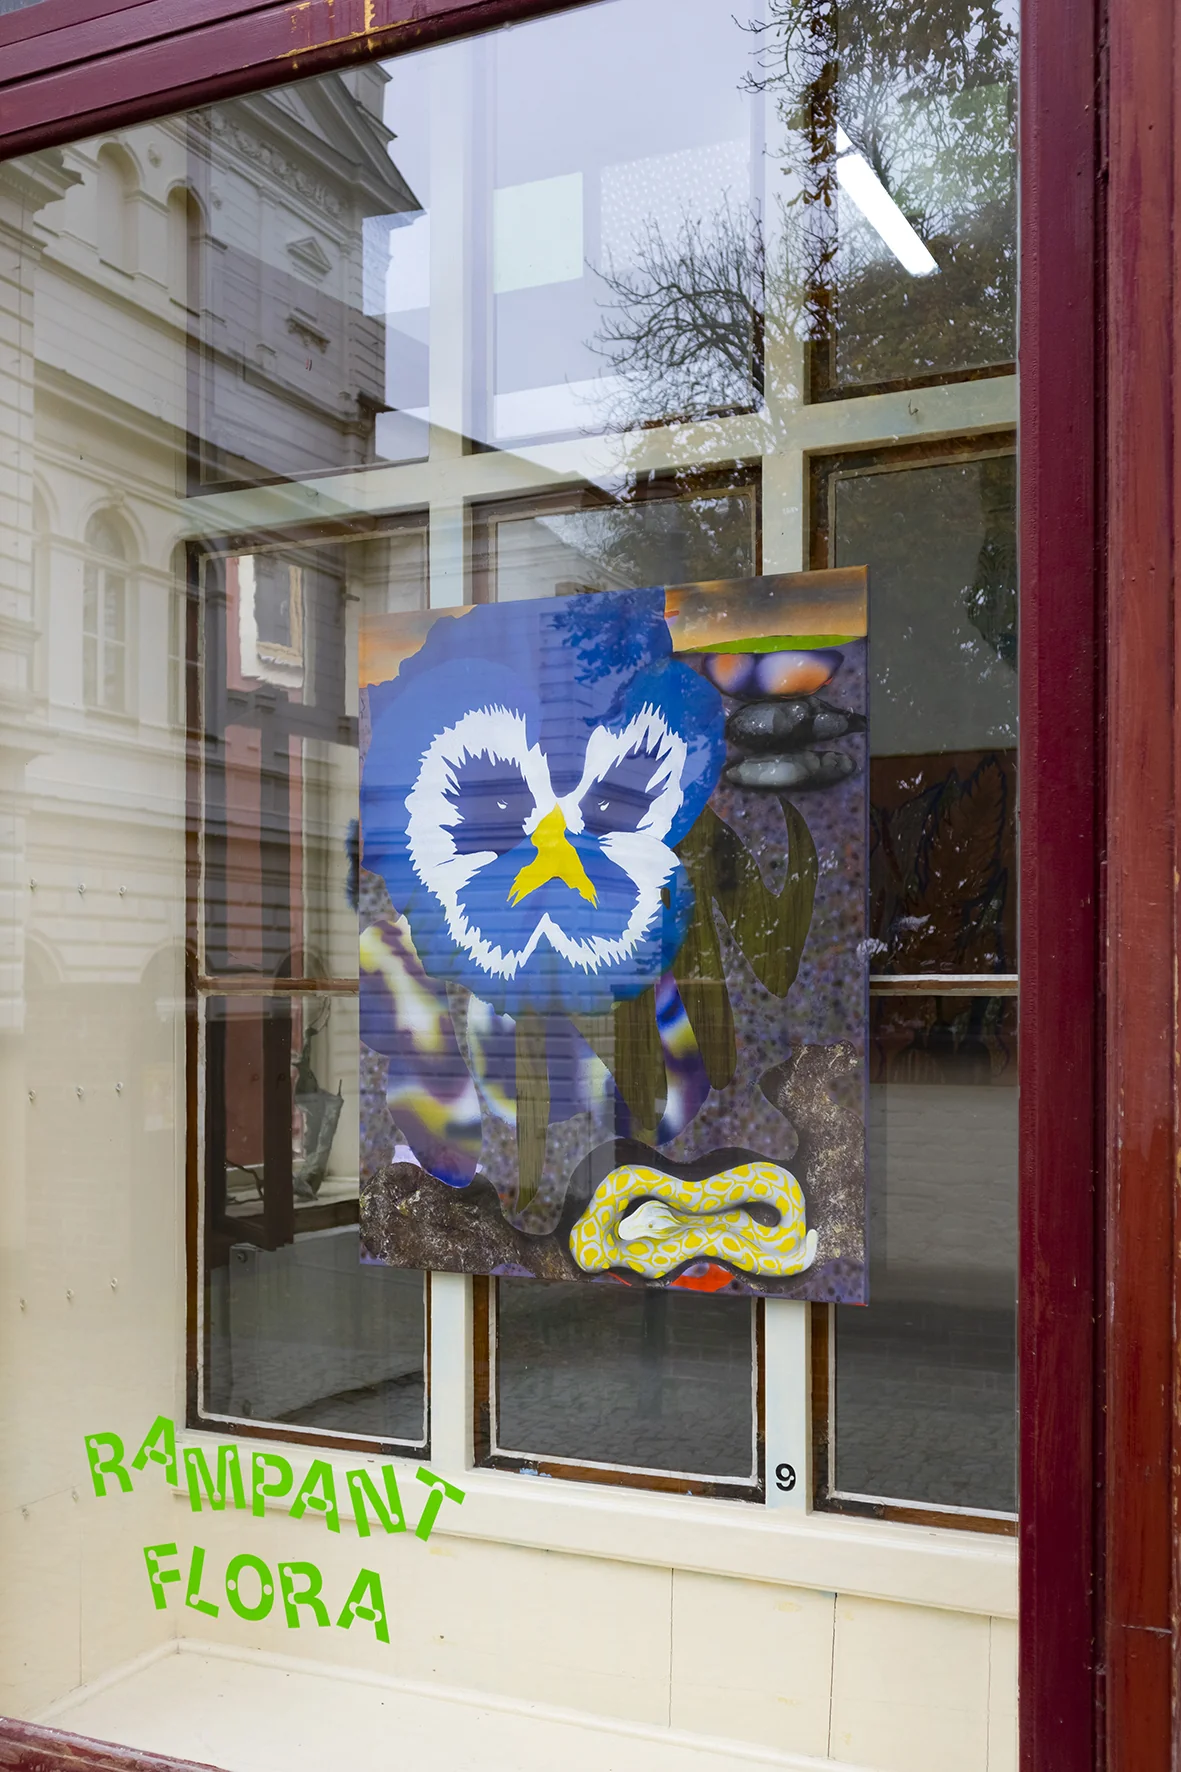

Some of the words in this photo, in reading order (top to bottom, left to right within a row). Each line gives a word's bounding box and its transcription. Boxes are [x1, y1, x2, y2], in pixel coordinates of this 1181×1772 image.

[84, 1415, 465, 1541] RAMPANT
[775, 1463, 796, 1491] 9
[144, 1542, 390, 1643] FLORA
